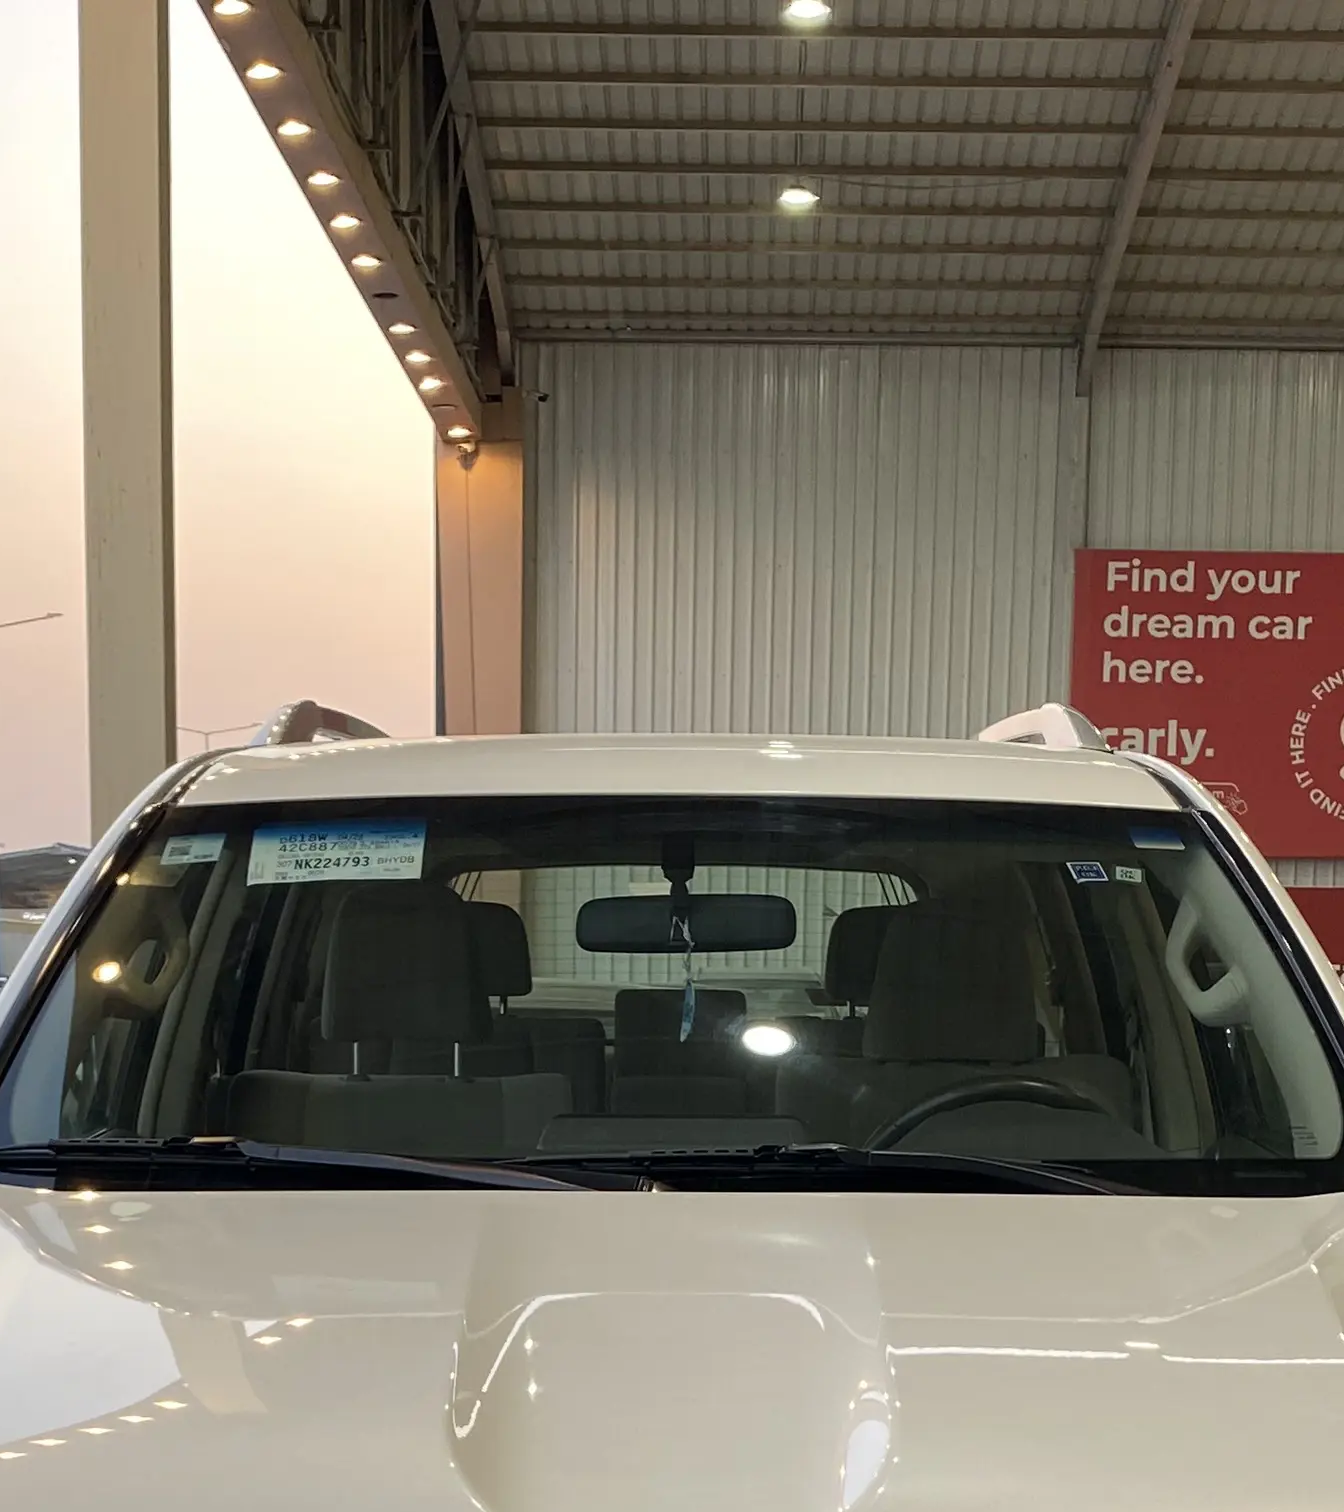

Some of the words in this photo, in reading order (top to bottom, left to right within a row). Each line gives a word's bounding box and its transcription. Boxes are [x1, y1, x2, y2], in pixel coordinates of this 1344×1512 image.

[1107, 558, 1196, 593] Find
[1206, 568, 1301, 601] your
[1103, 605, 1235, 639] dream
[1248, 613, 1313, 640] car
[1102, 651, 1205, 684] here.
[1289, 709, 1312, 765] HERE
[1294, 770, 1314, 788] IT
[293, 856, 370, 870] NK224793
